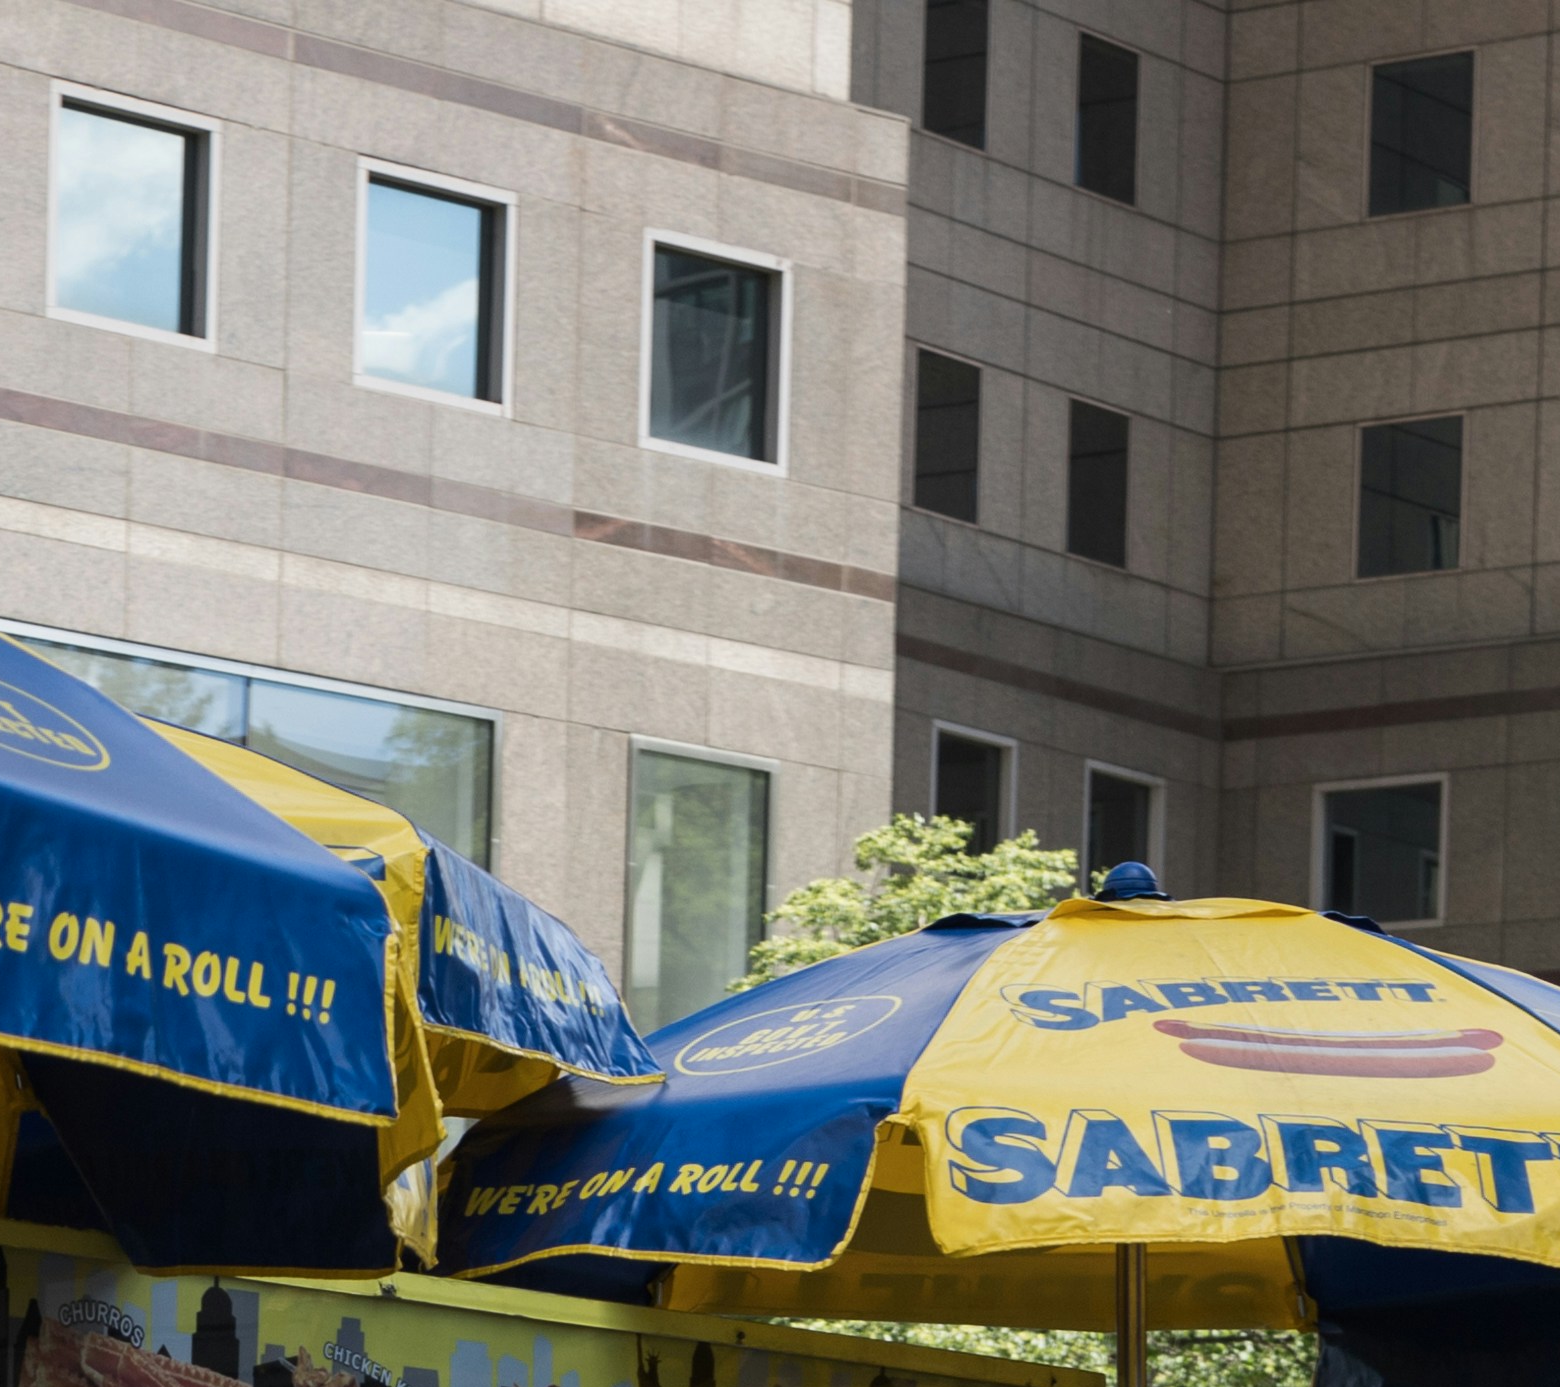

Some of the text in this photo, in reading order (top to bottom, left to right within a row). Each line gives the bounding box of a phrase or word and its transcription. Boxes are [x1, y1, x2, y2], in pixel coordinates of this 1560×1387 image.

[48, 911, 116, 968] ON
[126, 930, 151, 980] A
[163, 942, 271, 1009] ROLL
[1001, 976, 1437, 1031] SABRETT
[464, 1180, 579, 1218] WE'RE
[580, 1167, 635, 1200] ON
[633, 1162, 666, 1195] A
[670, 1160, 763, 1195] ROLL
[60, 1302, 144, 1347] CHURROS
[323, 1343, 393, 1385] CHICKEN
